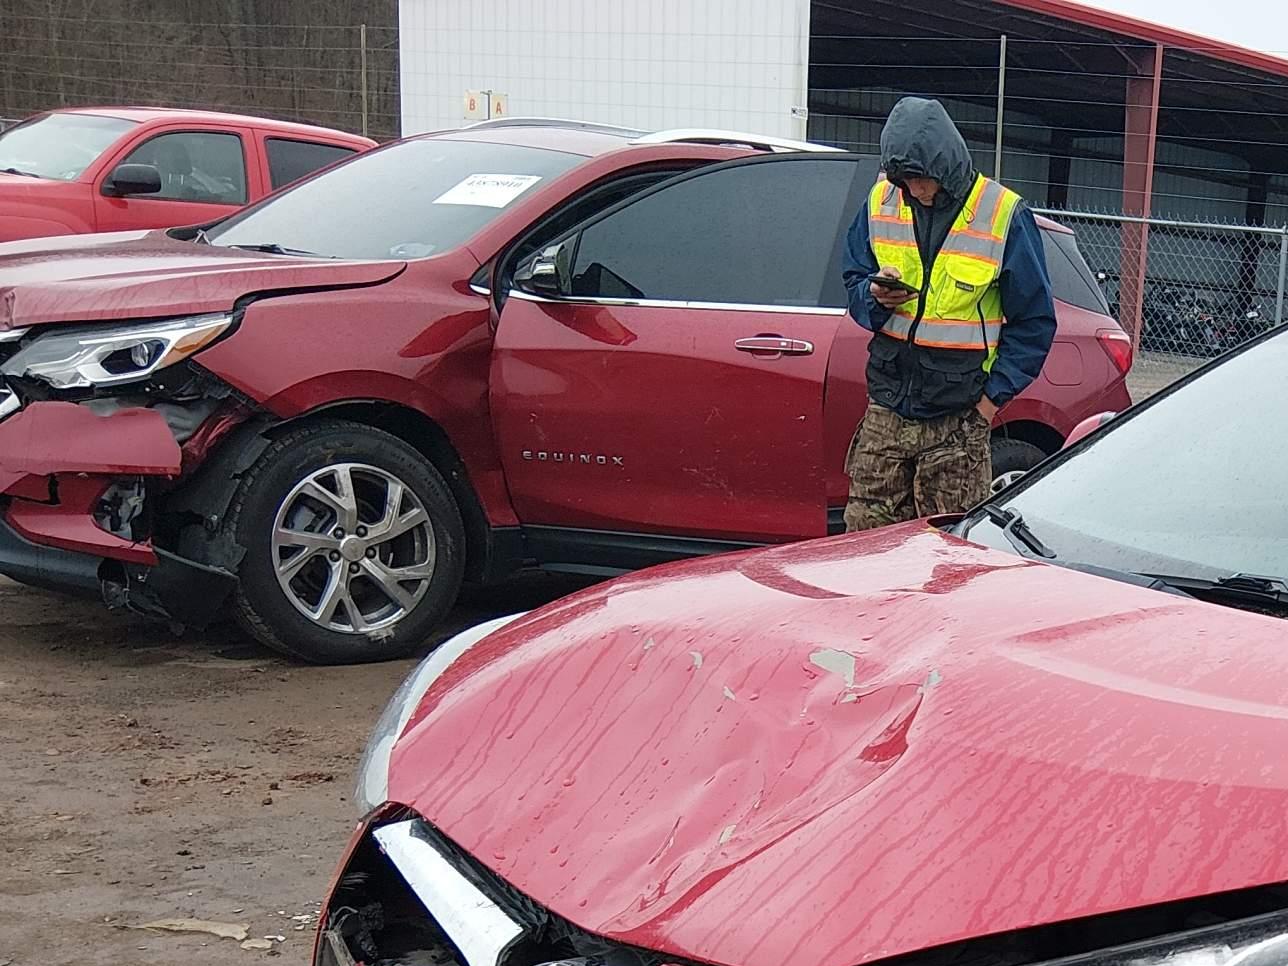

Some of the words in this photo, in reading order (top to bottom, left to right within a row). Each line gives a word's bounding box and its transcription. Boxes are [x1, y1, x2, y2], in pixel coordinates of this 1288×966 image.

[469, 98, 476, 111] B
[495, 101, 502, 114] A
[522, 450, 624, 466] EQUINOX
